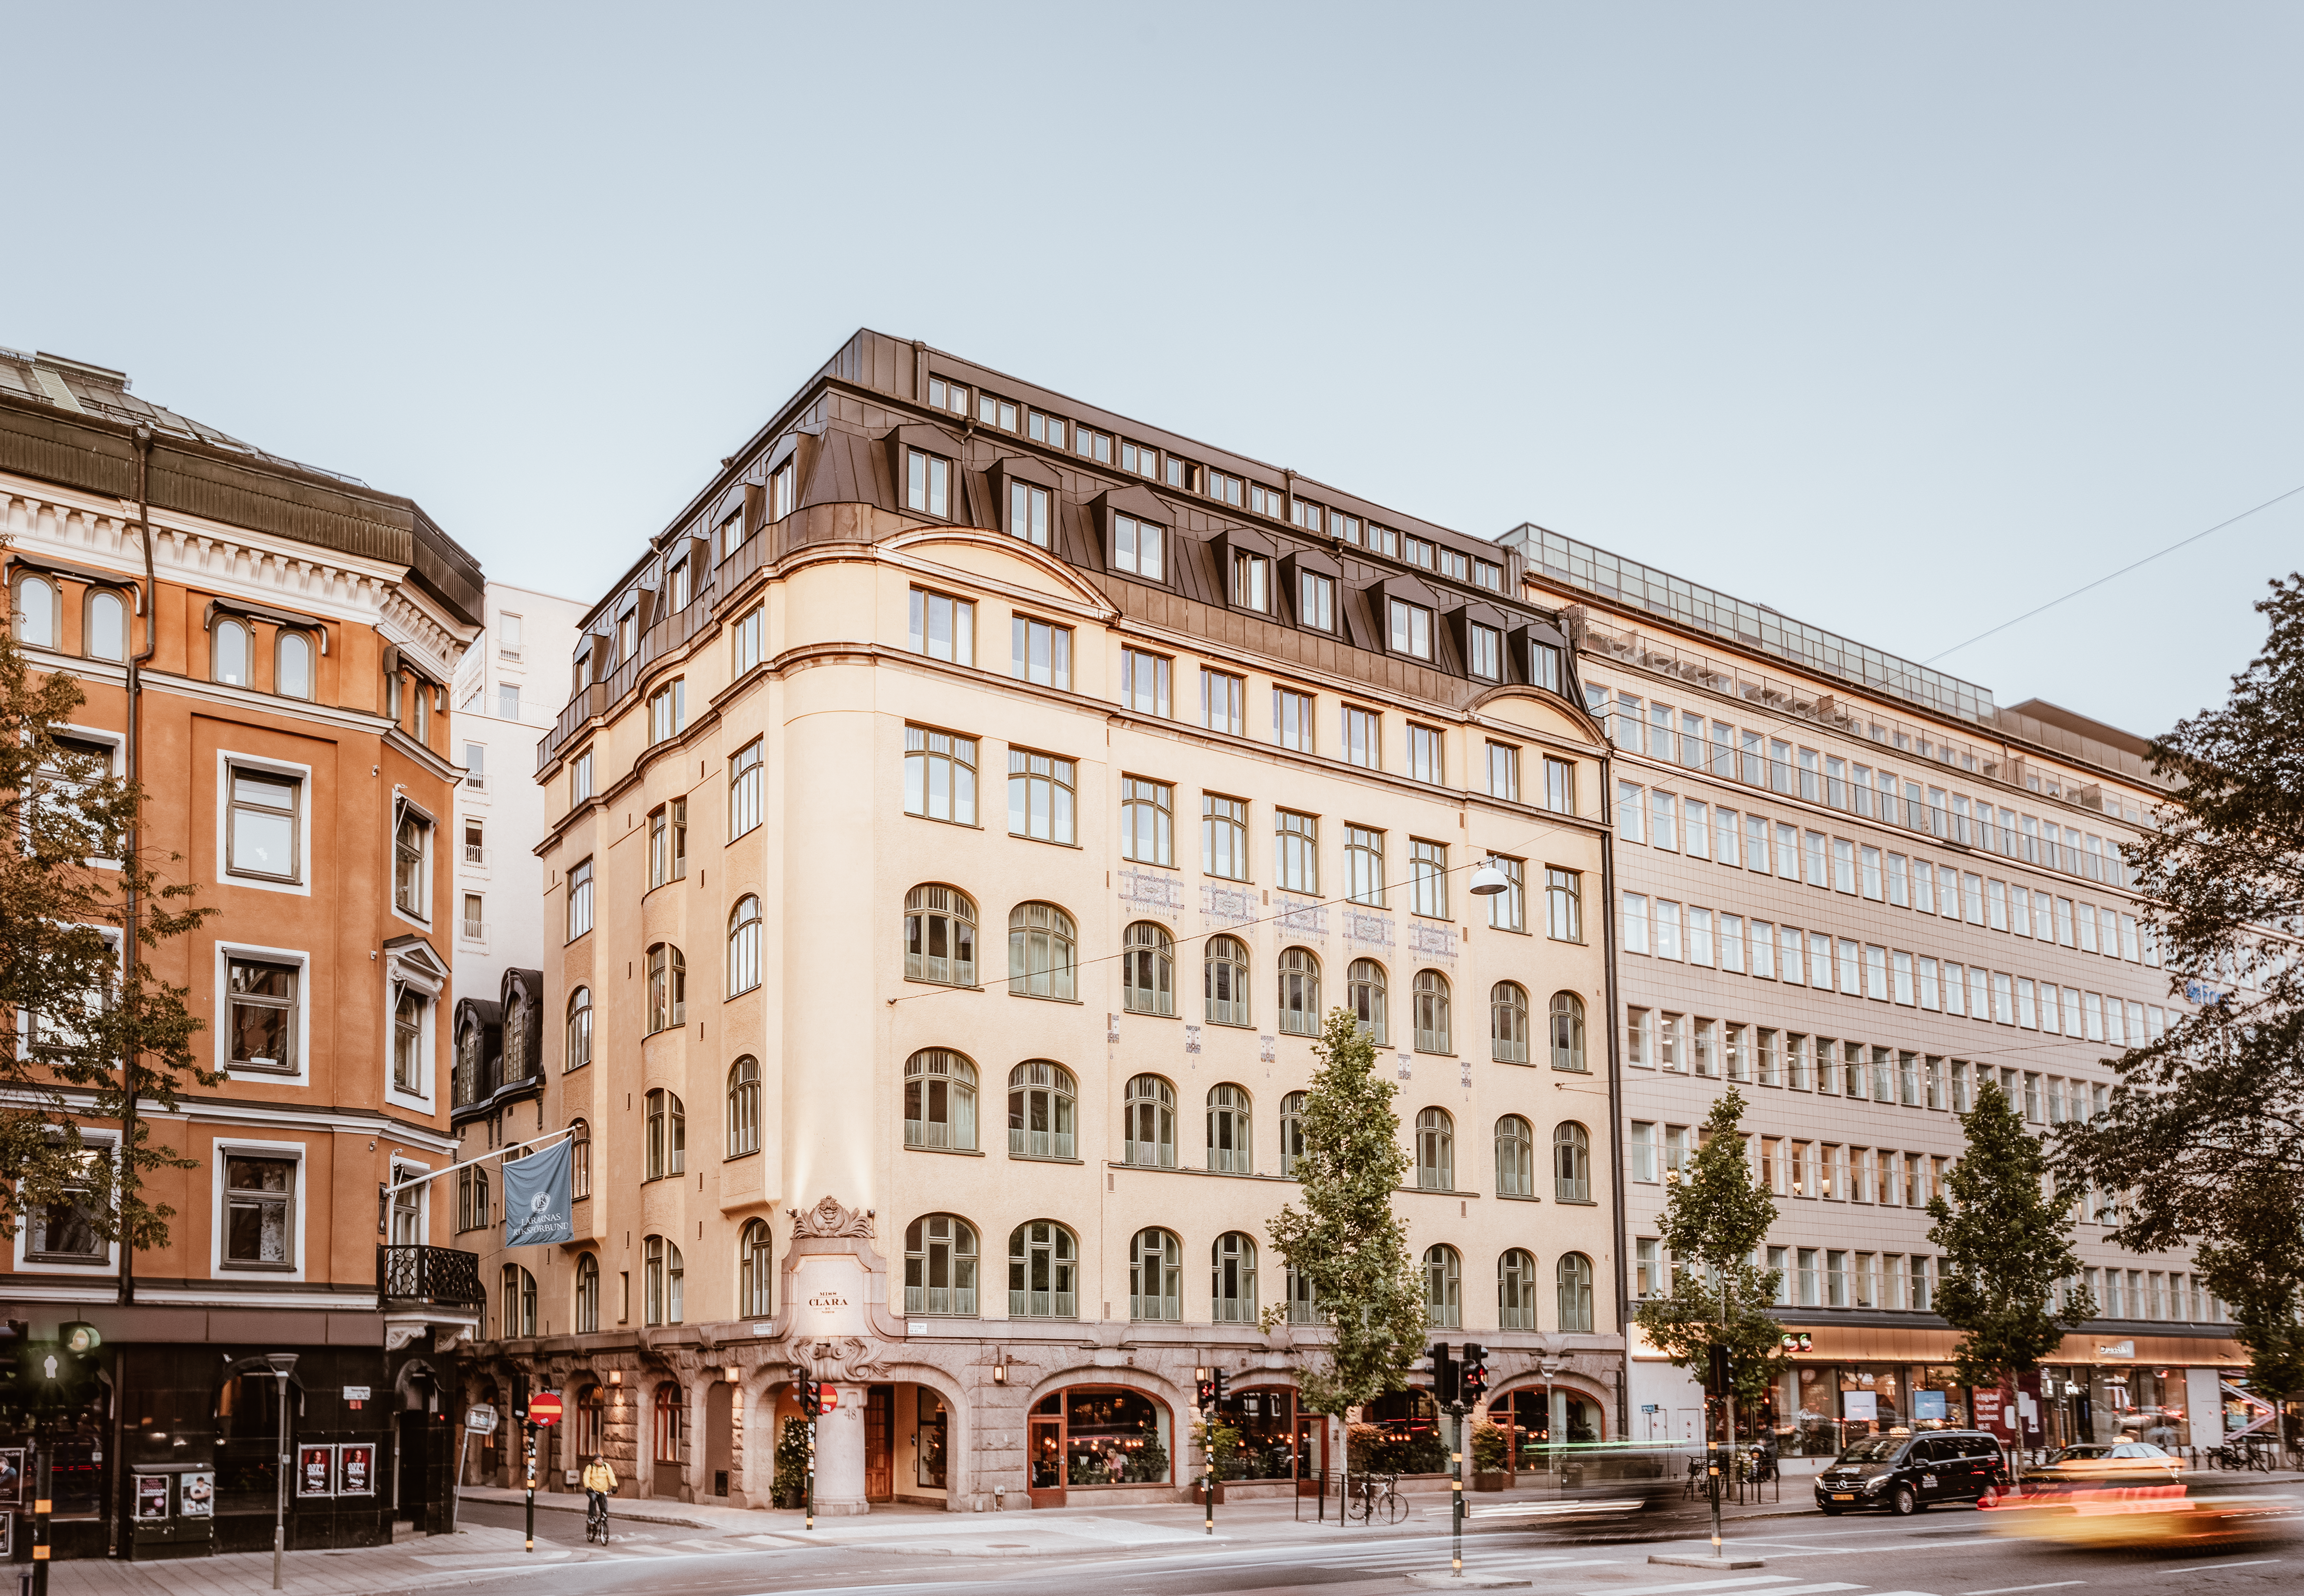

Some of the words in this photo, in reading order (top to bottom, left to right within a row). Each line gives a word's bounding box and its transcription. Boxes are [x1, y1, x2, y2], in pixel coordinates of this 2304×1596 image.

[521, 1213, 561, 1226] LÄRARNAS
[513, 1222, 569, 1236] RIKSFÖRBUND
[844, 1409, 857, 1420] 48
[307, 1463, 325, 1472] OZZY
[347, 1462, 365, 1472] OZZY
